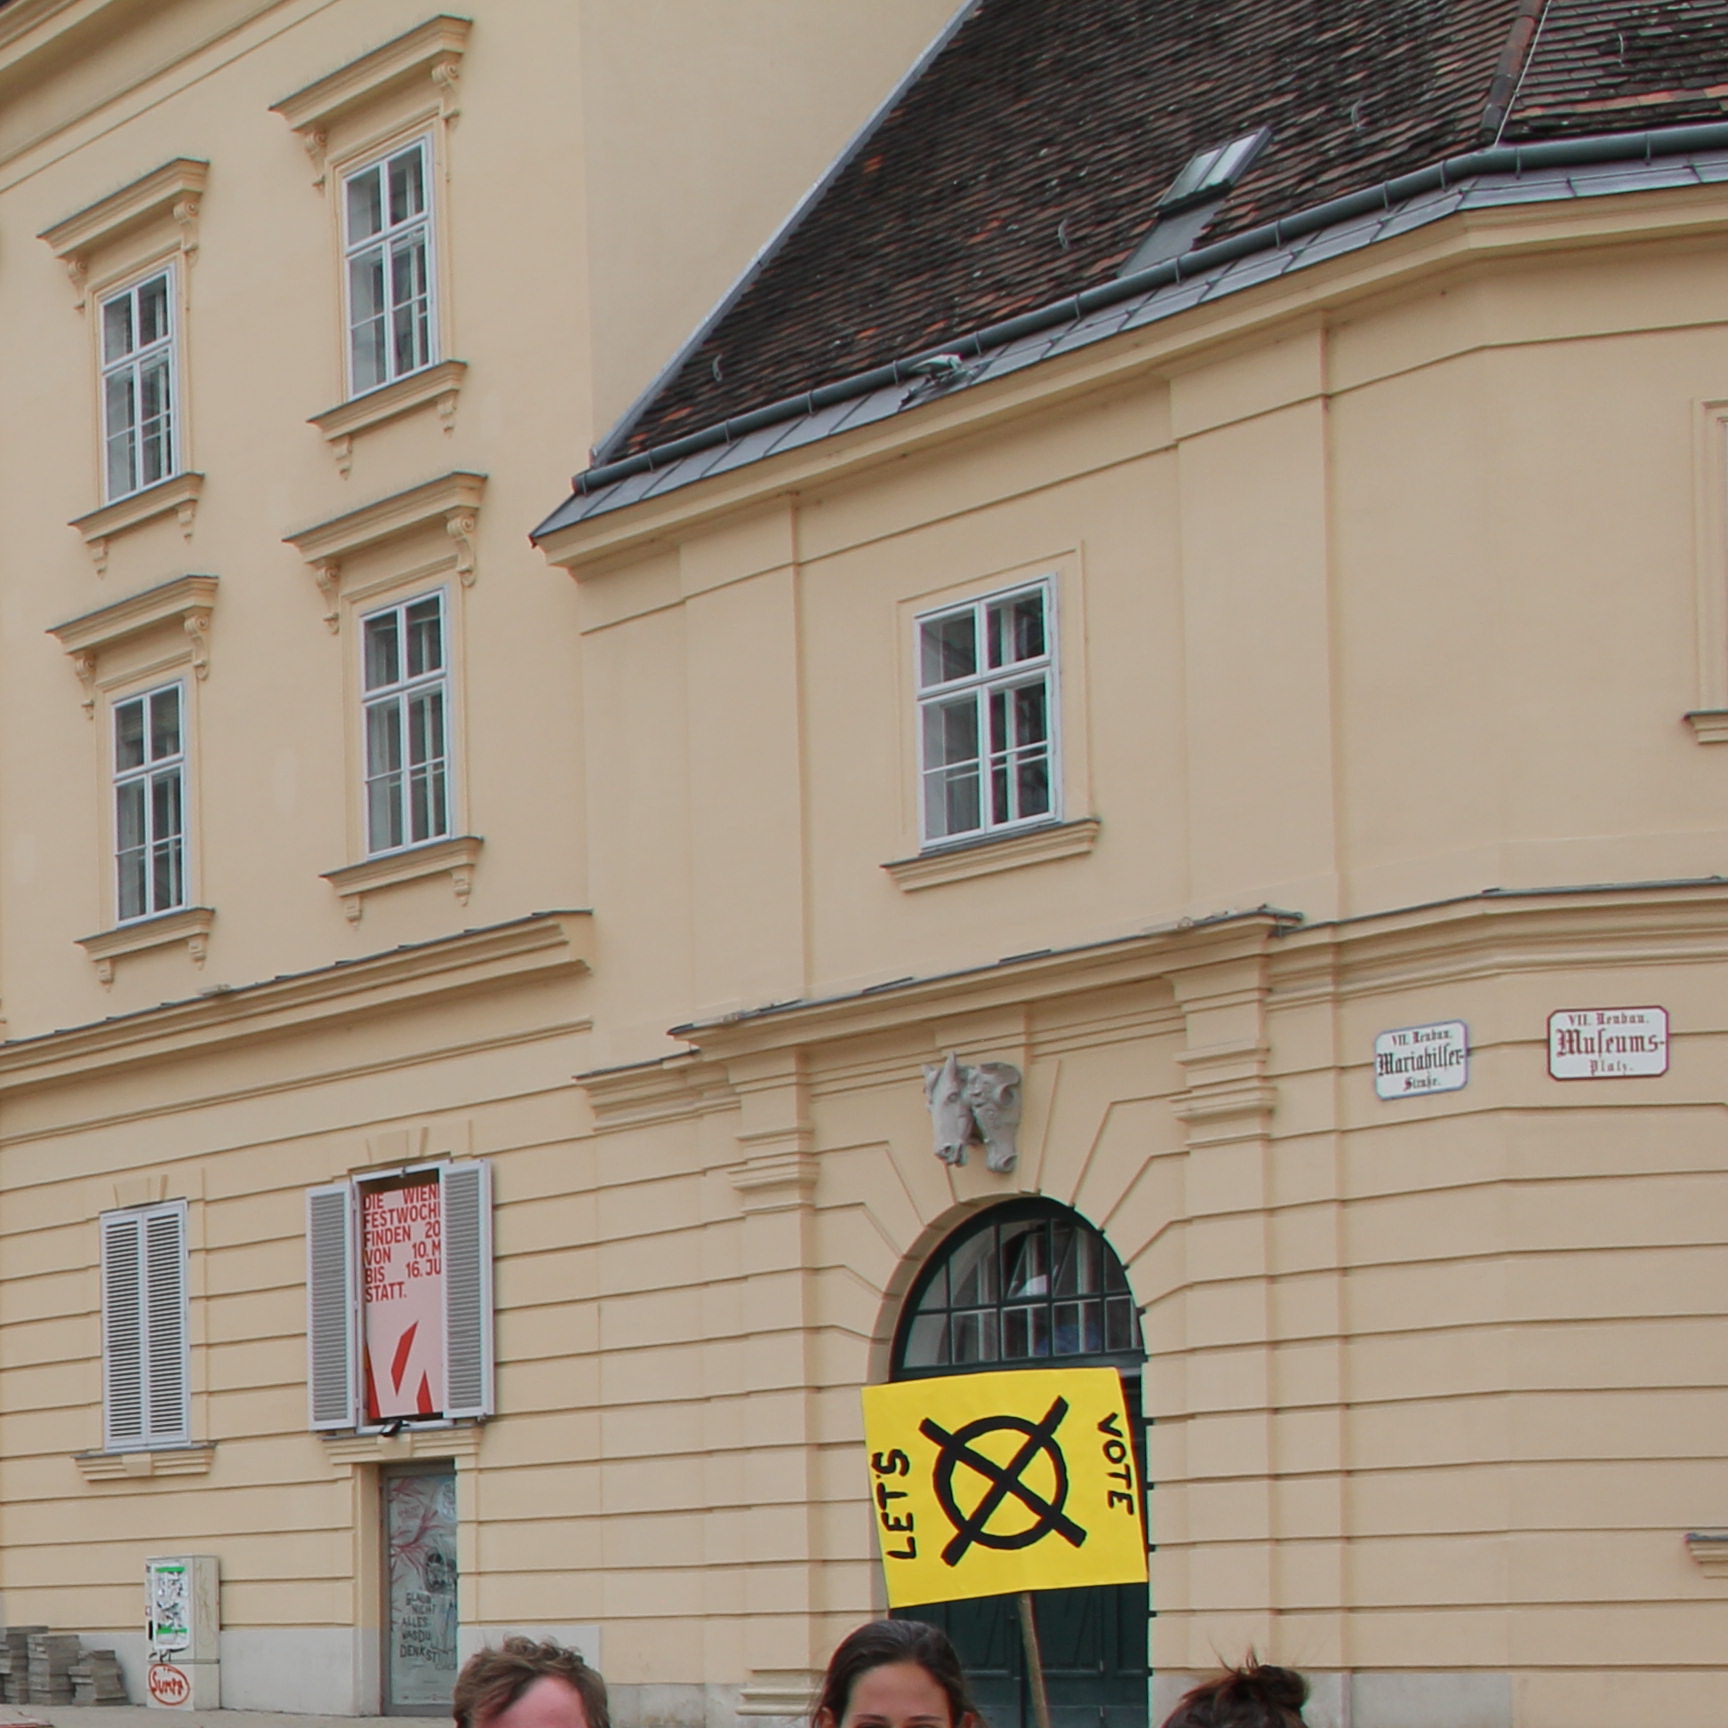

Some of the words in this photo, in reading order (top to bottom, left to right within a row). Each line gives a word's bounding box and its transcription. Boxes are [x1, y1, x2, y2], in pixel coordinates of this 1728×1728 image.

[363, 1192, 384, 1212] DIE
[402, 1183, 441, 1205] WIEN
[363, 1201, 441, 1230] FESTWOCH
[363, 1225, 412, 1248] FINDEN
[364, 1247, 392, 1266] VON
[364, 1265, 386, 1285] BIS
[365, 1281, 407, 1304] STATT.
[1097, 1411, 1135, 1516] VOTE
[870, 1448, 918, 1560] LET'S
